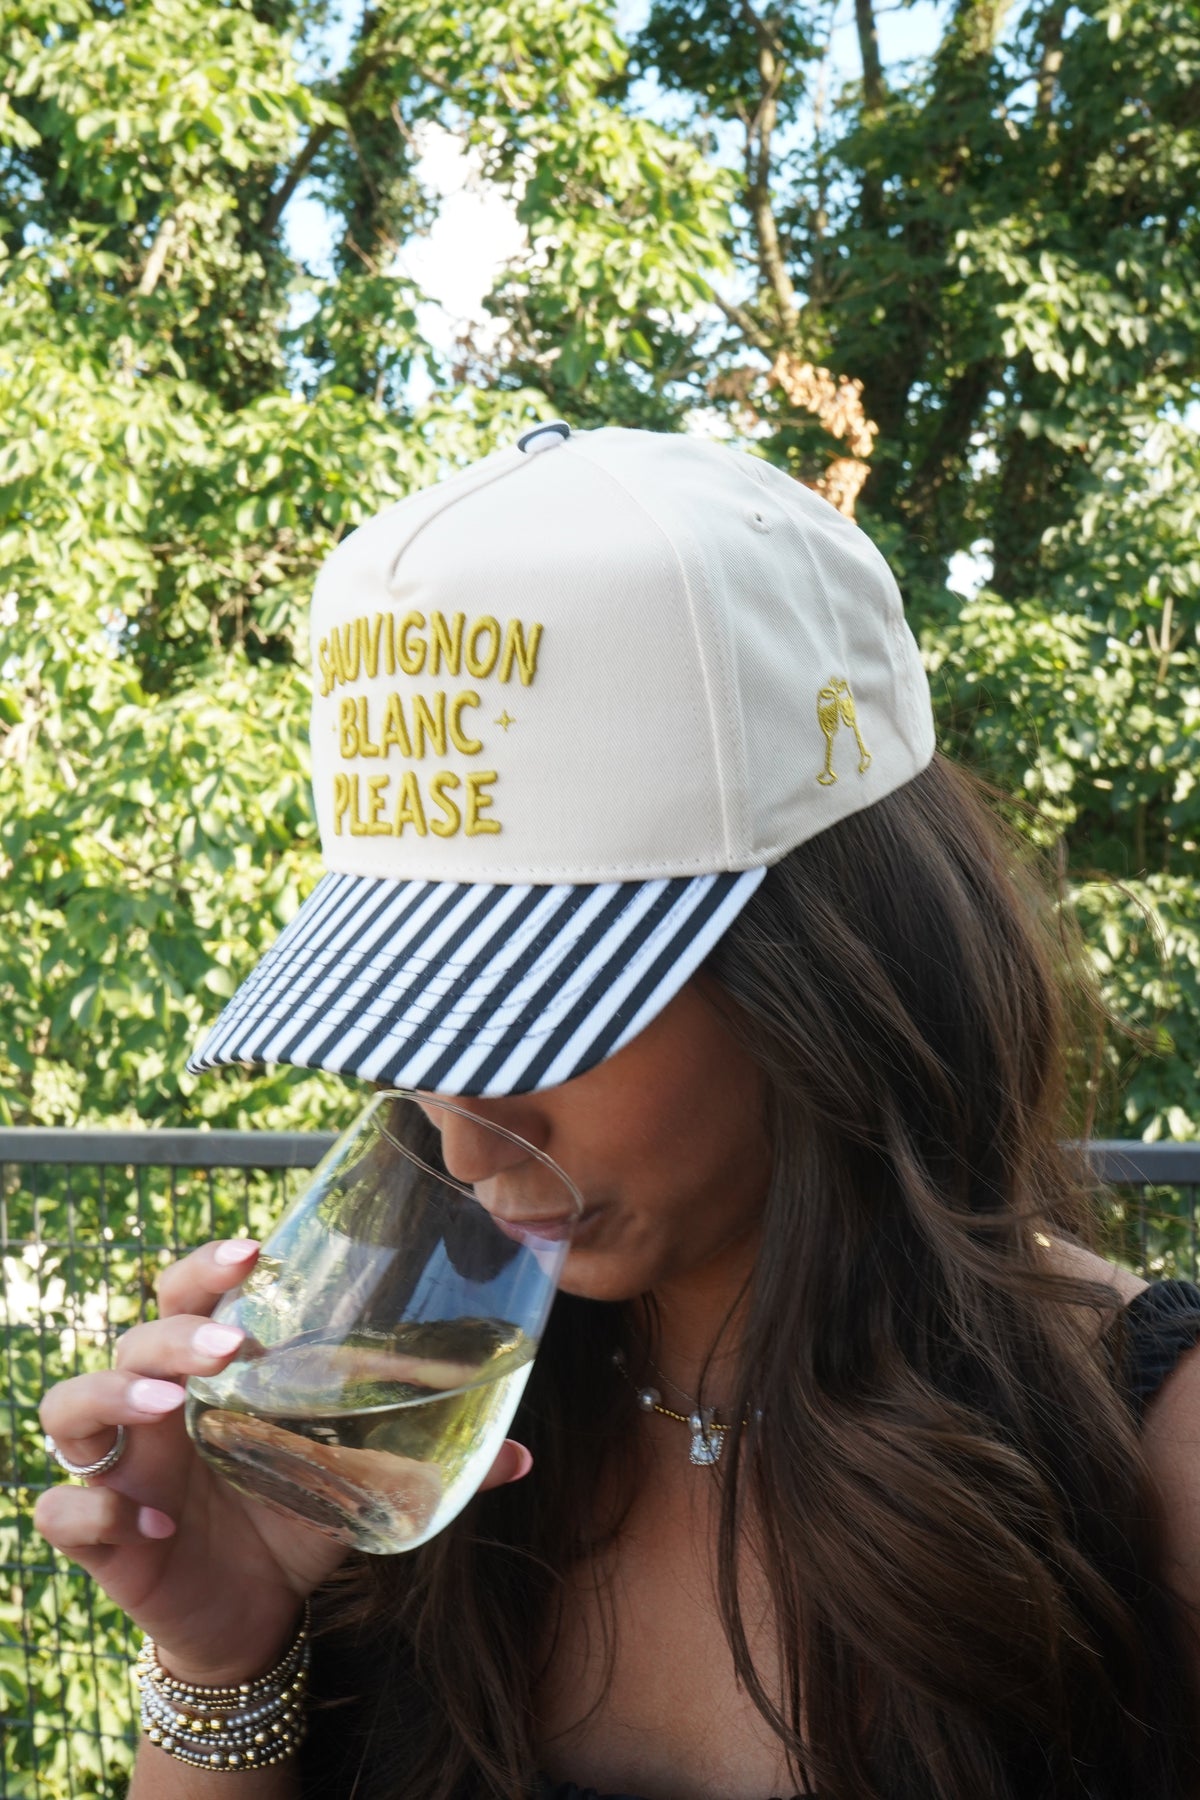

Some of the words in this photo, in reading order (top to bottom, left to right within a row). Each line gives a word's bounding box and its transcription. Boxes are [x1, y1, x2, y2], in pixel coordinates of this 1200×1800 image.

[318, 610, 544, 697] SAUVIGNON
[339, 690, 484, 760] BLANC
[333, 770, 502, 838] PLEASE
